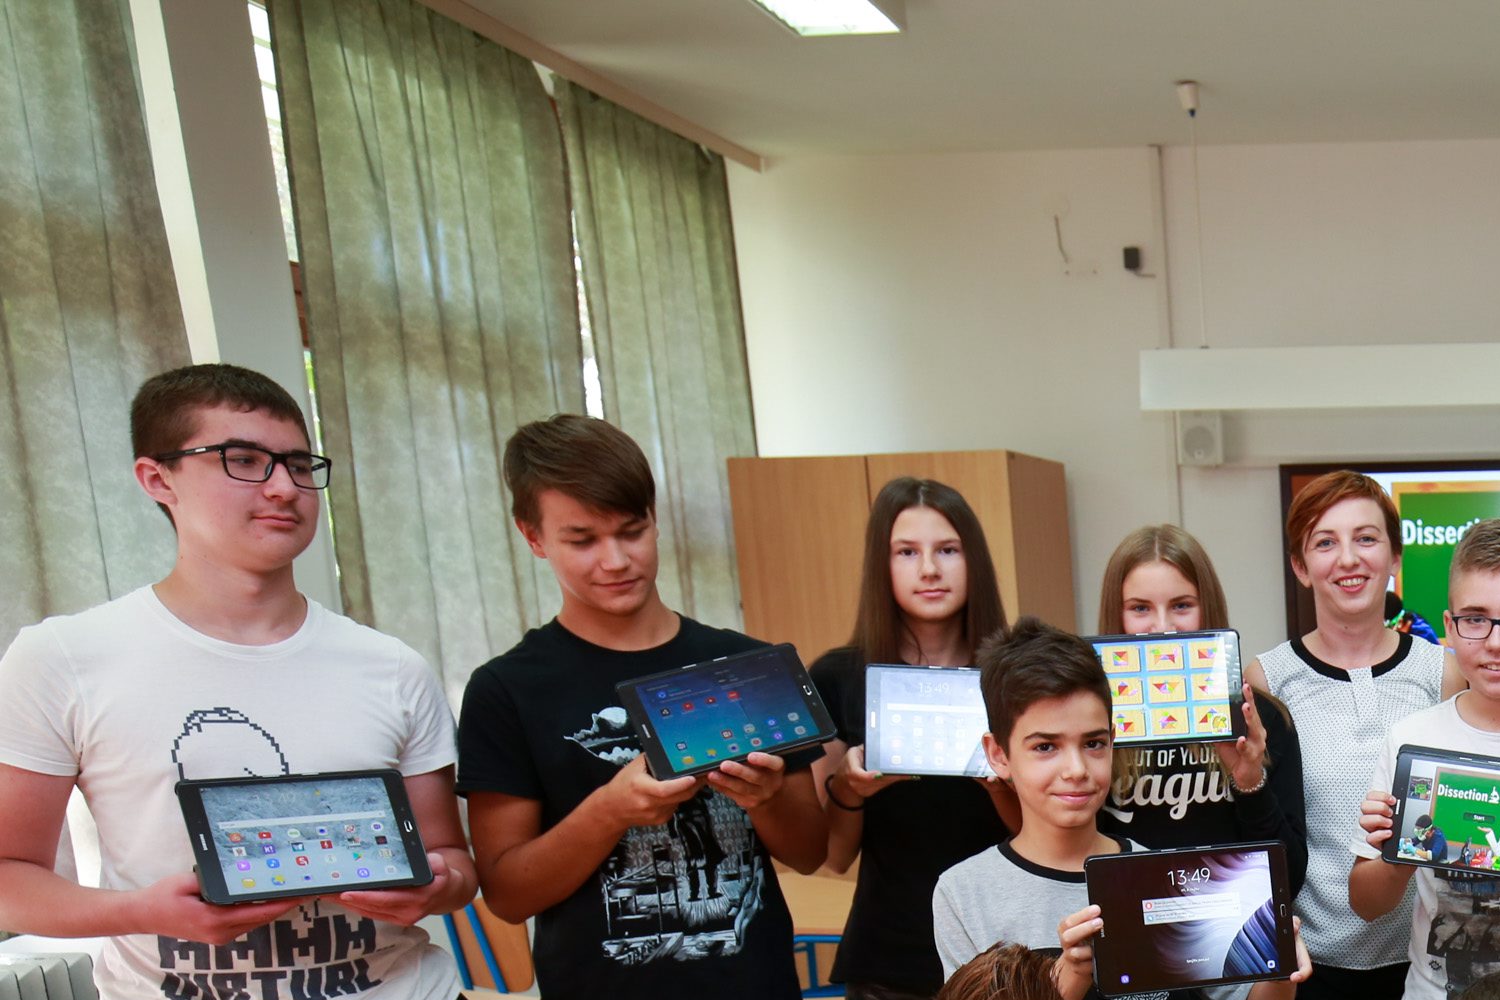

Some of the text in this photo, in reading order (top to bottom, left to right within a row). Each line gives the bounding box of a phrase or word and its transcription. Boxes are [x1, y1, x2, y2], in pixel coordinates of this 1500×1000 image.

[1157, 749, 1177, 768] OF
[1437, 783, 1489, 803] Dissection
[1167, 866, 1211, 887] 13:49
